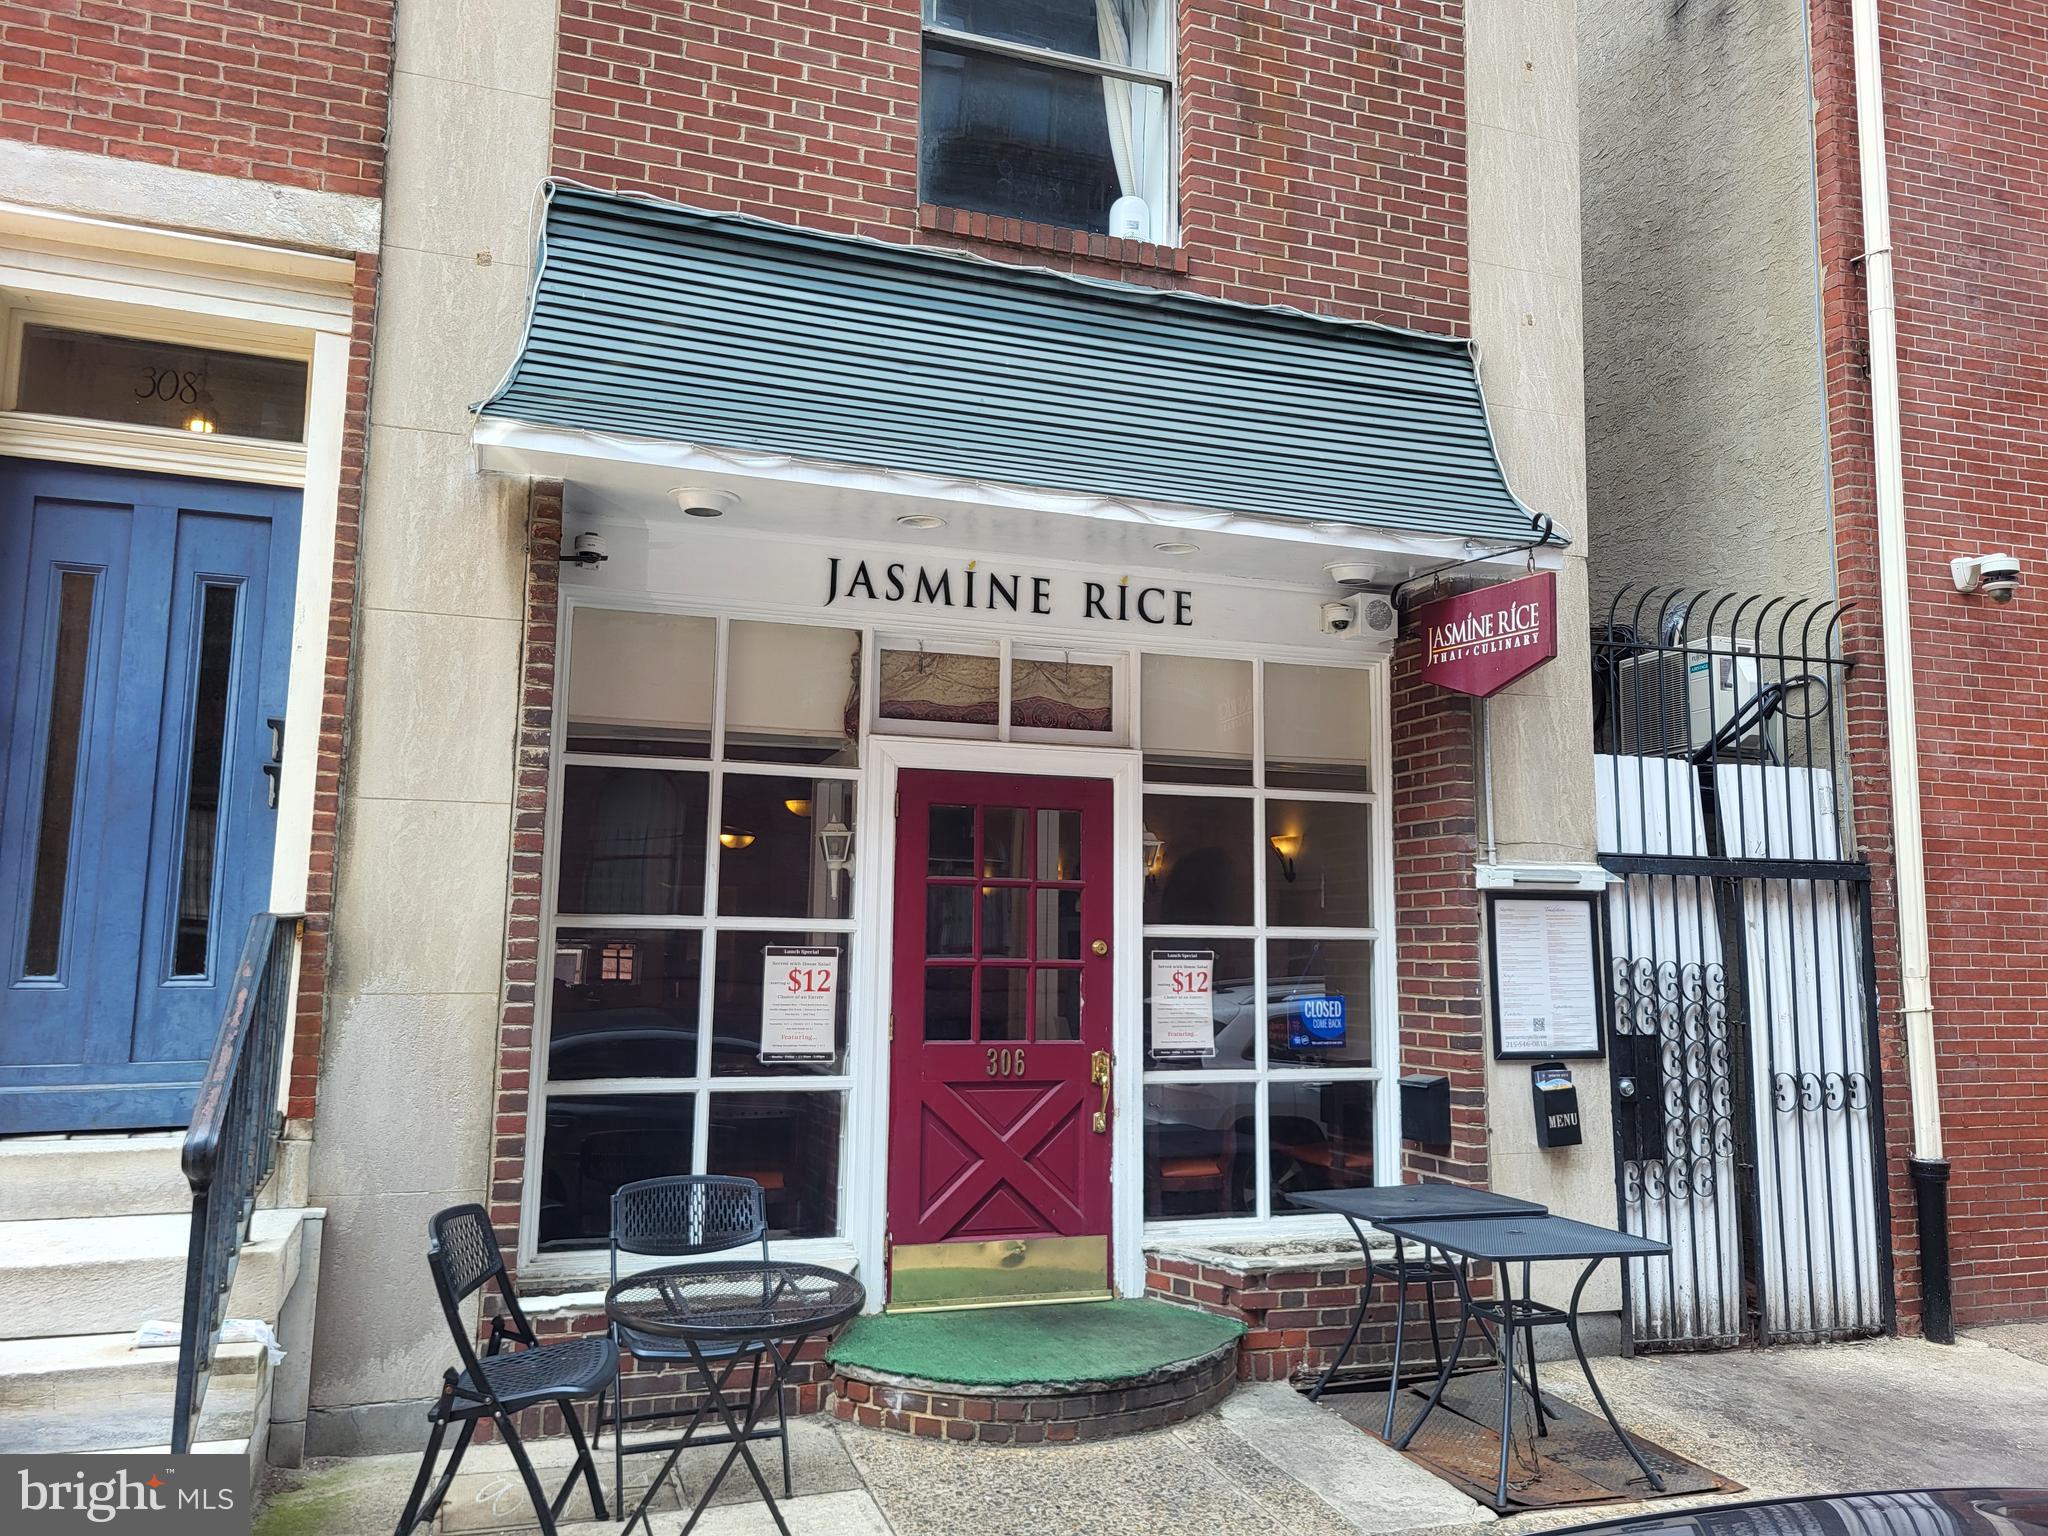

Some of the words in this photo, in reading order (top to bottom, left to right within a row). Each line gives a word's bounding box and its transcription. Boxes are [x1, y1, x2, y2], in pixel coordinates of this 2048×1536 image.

[134, 366, 199, 405] 308
[1433, 648, 1462, 664] THAI
[1473, 632, 1539, 656] CULINARY
[788, 966, 831, 994] $12
[1172, 970, 1208, 994] $12
[1304, 1001, 1342, 1018] CLOSED
[1313, 1018, 1328, 1029] COME
[1328, 1018, 1342, 1029] BACK
[986, 1048, 1025, 1076] 306
[1548, 1112, 1578, 1129] MENU
